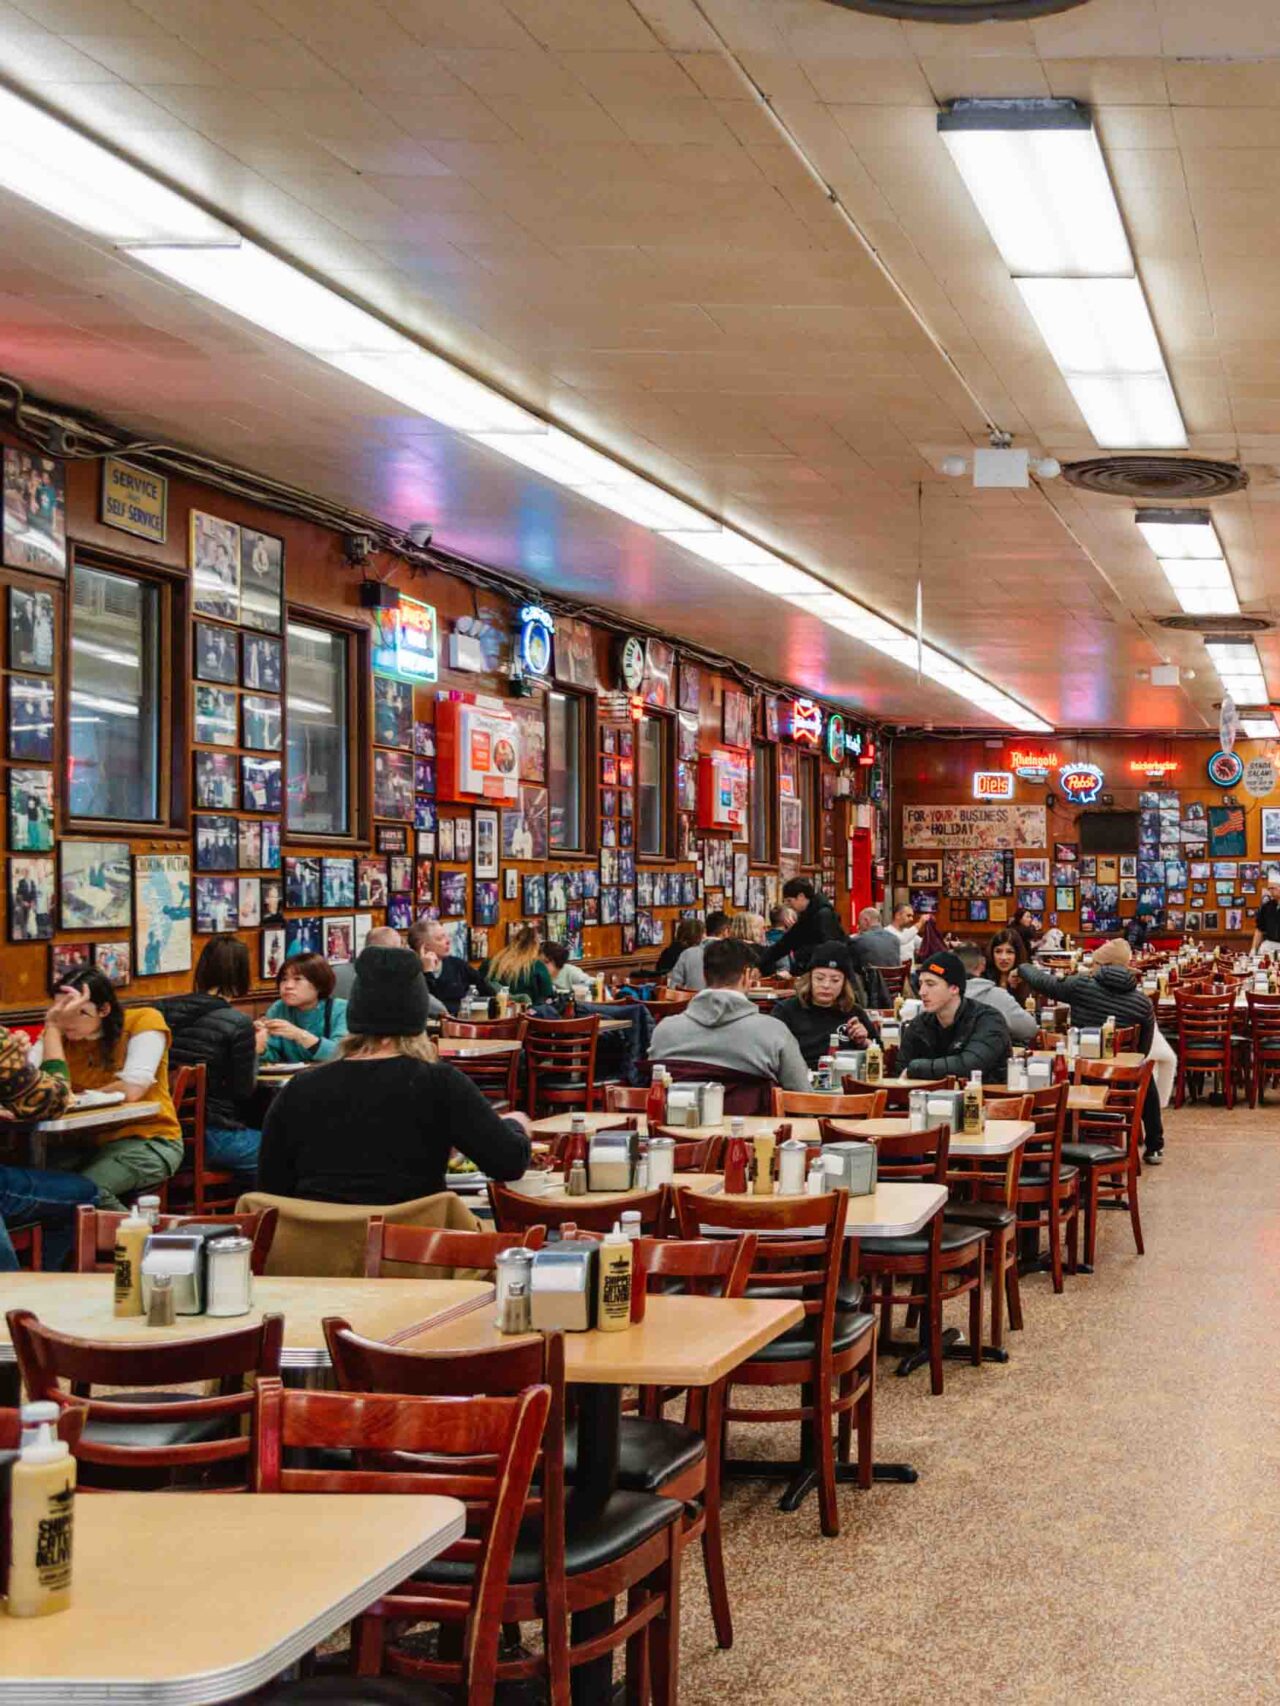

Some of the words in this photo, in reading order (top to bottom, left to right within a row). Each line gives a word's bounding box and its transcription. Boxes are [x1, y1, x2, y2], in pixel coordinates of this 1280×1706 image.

[112, 469, 157, 499] SERVICE
[107, 497, 125, 517] SELF
[128, 504, 163, 531] SERVICE
[1010, 751, 1058, 768] Rheingold
[907, 810, 926, 822] FOR
[930, 810, 954, 822] YOUR
[960, 809, 1008, 822] BUSINESS
[931, 823, 974, 835] HOLIDAY
